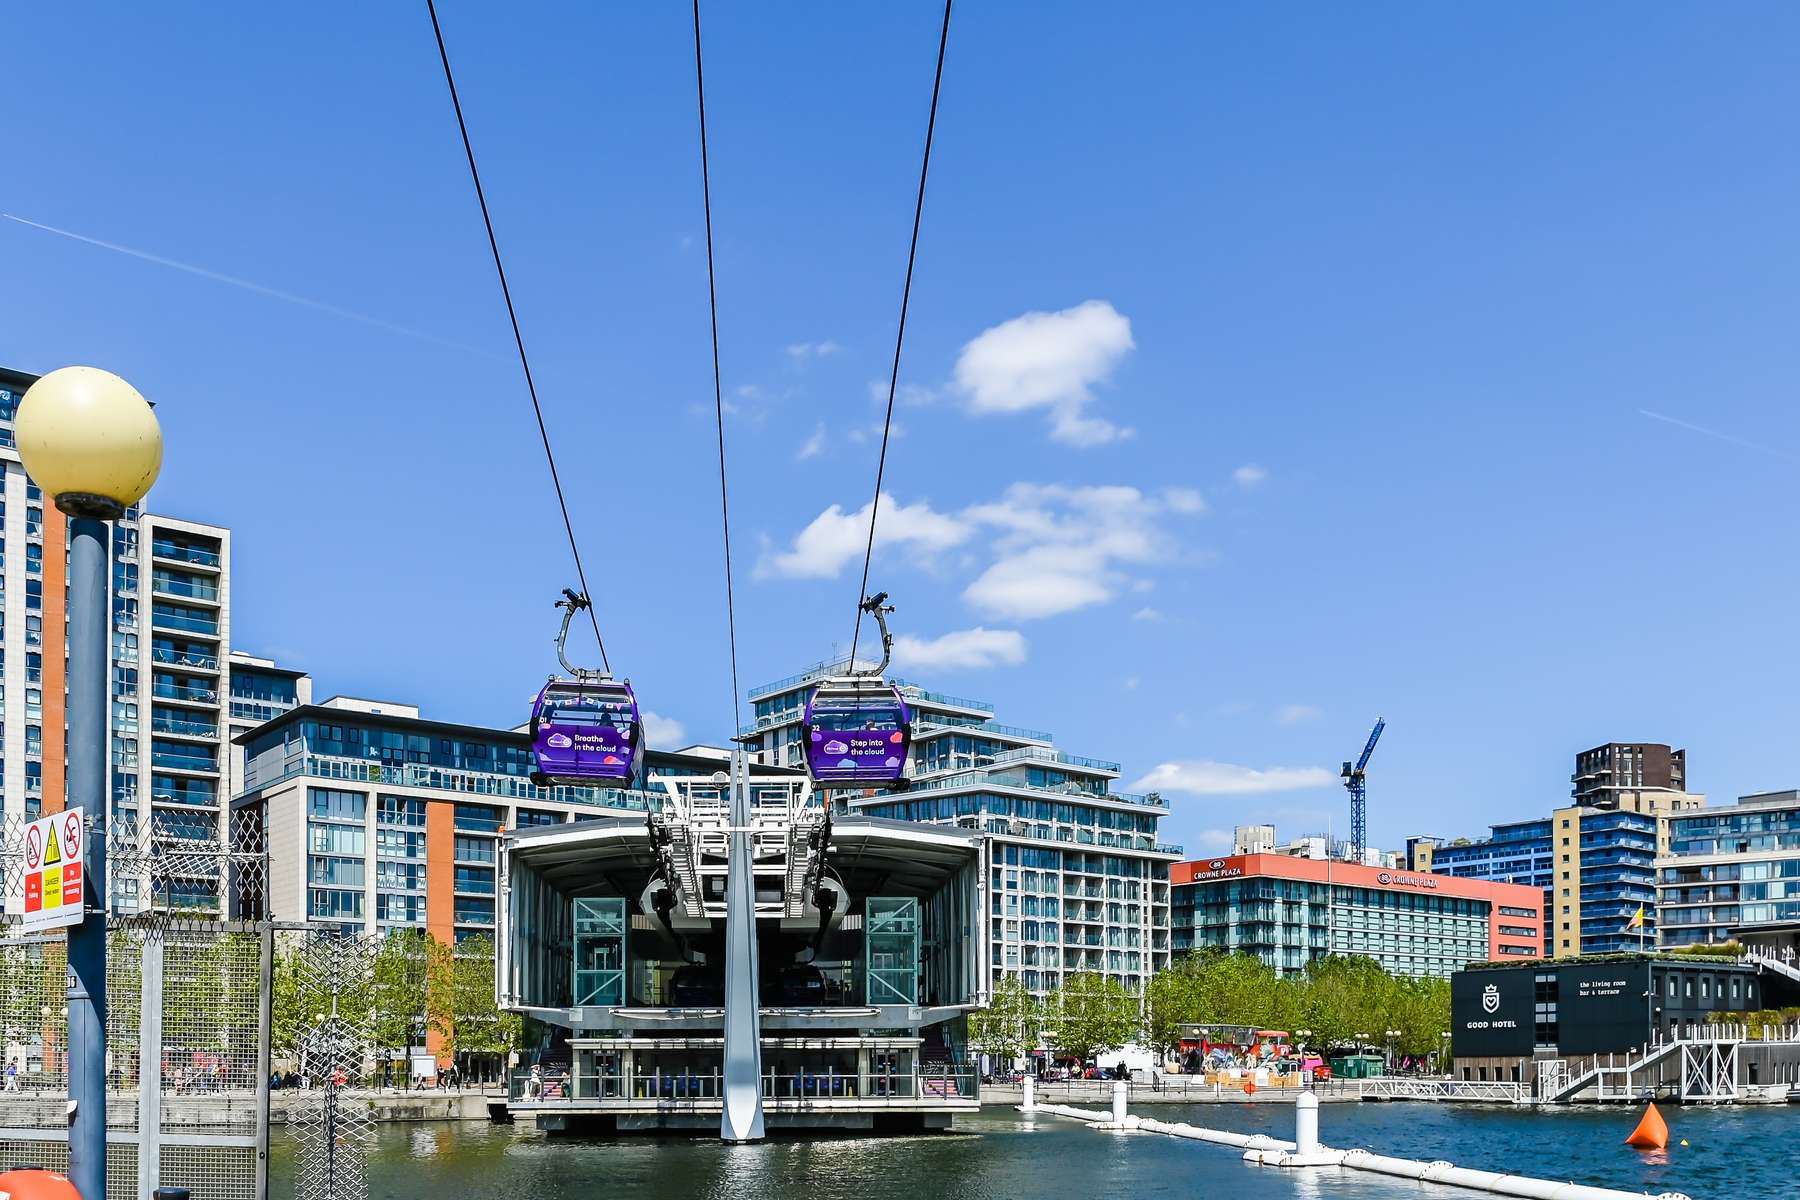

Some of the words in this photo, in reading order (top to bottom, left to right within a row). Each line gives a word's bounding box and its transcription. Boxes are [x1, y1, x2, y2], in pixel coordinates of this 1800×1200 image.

[574, 734, 604, 743] Breathe
[574, 743, 582, 751] in
[582, 744, 595, 752] the
[596, 745, 617, 753] cloud
[850, 739, 867, 748] Step
[868, 739, 884, 747] into
[851, 748, 864, 756] the
[1193, 870, 1220, 880] CROWNE
[1221, 868, 1241, 877] PLAZA
[1392, 874, 1418, 886] CROWNE
[1419, 878, 1438, 888] PLAZA
[1467, 1021, 1489, 1029] GOOD
[1492, 1020, 1517, 1028] HOTEL
